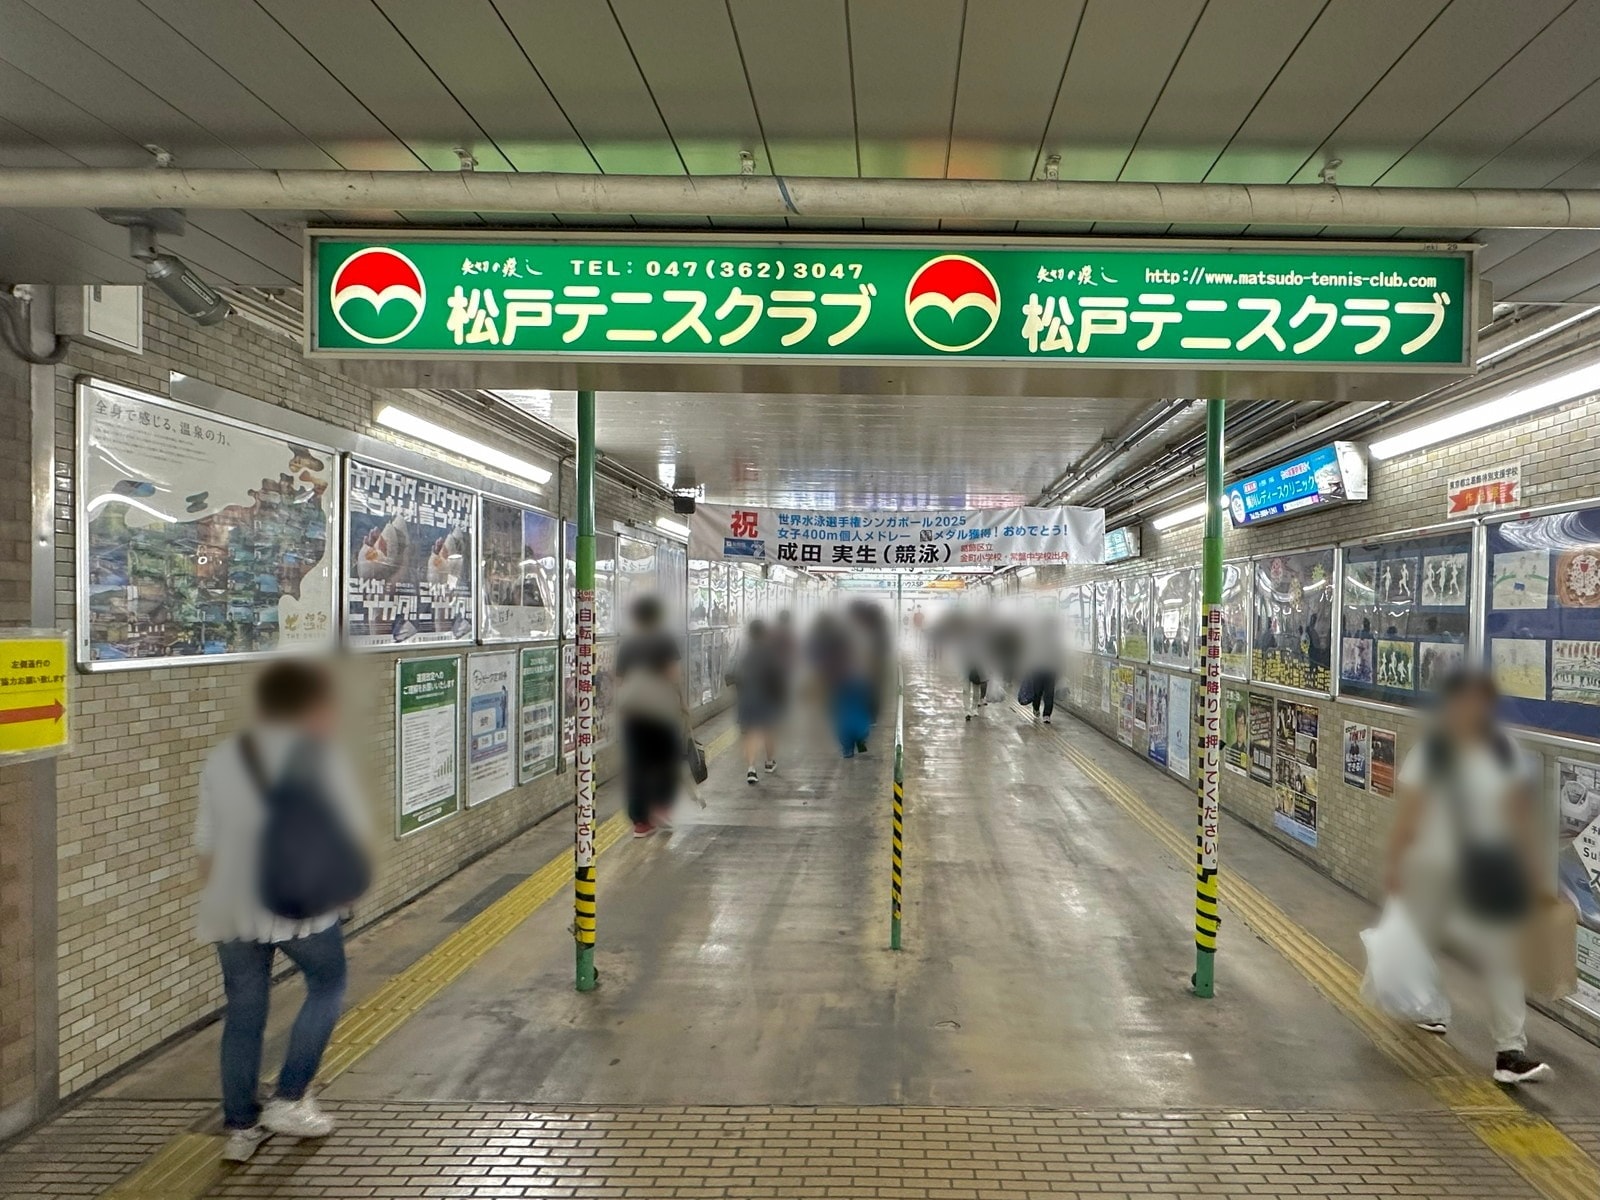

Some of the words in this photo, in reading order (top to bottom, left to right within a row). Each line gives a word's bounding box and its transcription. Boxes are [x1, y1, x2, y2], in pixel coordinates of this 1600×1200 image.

[646, 259, 863, 280] 047(362)3047
[1145, 267, 1437, 288] http://www.matsudo-tennis-club.com
[447, 283, 877, 346] 松戸テニスクラブ
[1022, 291, 1451, 354] 松戸テニスクラブ
[730, 510, 758, 538] 祝
[778, 513, 967, 528] 世界水泳選手権シンガポール2025
[777, 527, 911, 542] 女子400m個人メドレー
[777, 543, 822, 563] 成田
[578, 608, 593, 862] 自転車は降りて押してください。
[1204, 609, 1221, 864] 自転車は降りて押してください。
